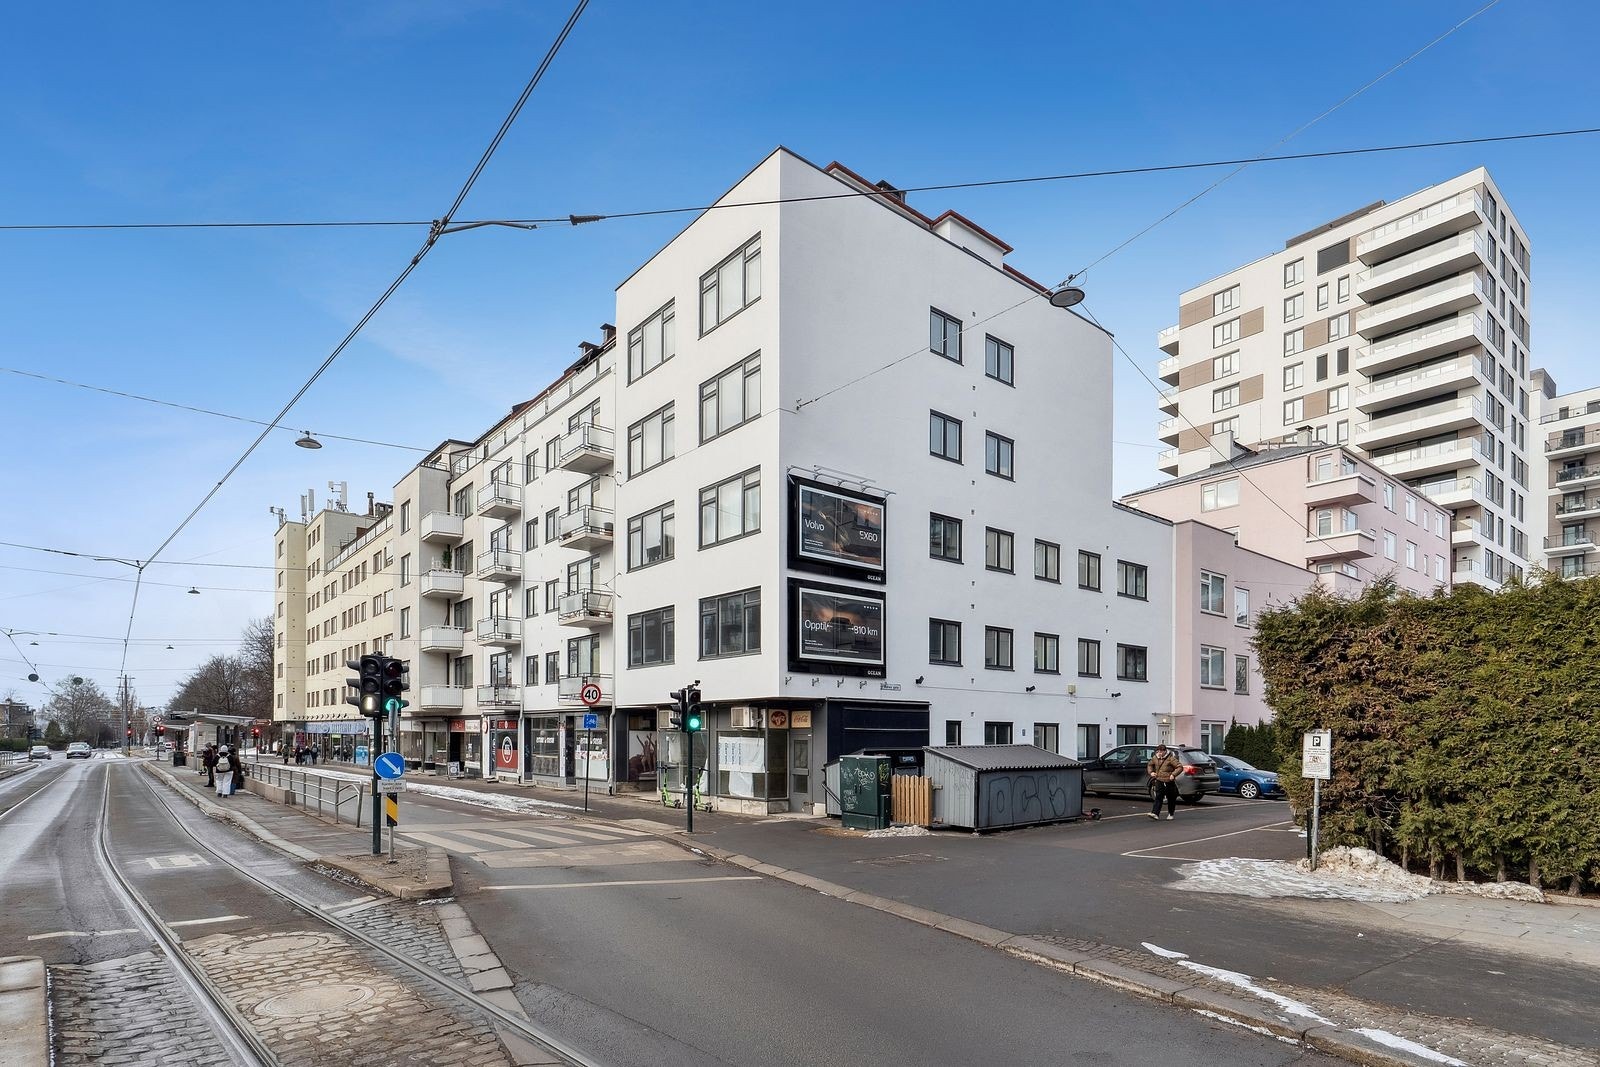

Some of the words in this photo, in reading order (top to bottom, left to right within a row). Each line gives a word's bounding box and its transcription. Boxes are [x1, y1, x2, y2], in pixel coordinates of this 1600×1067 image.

[804, 518, 825, 531] Volvo
[853, 625, 866, 635] 810
[867, 626, 878, 636] km
[585, 689, 598, 700] 40
